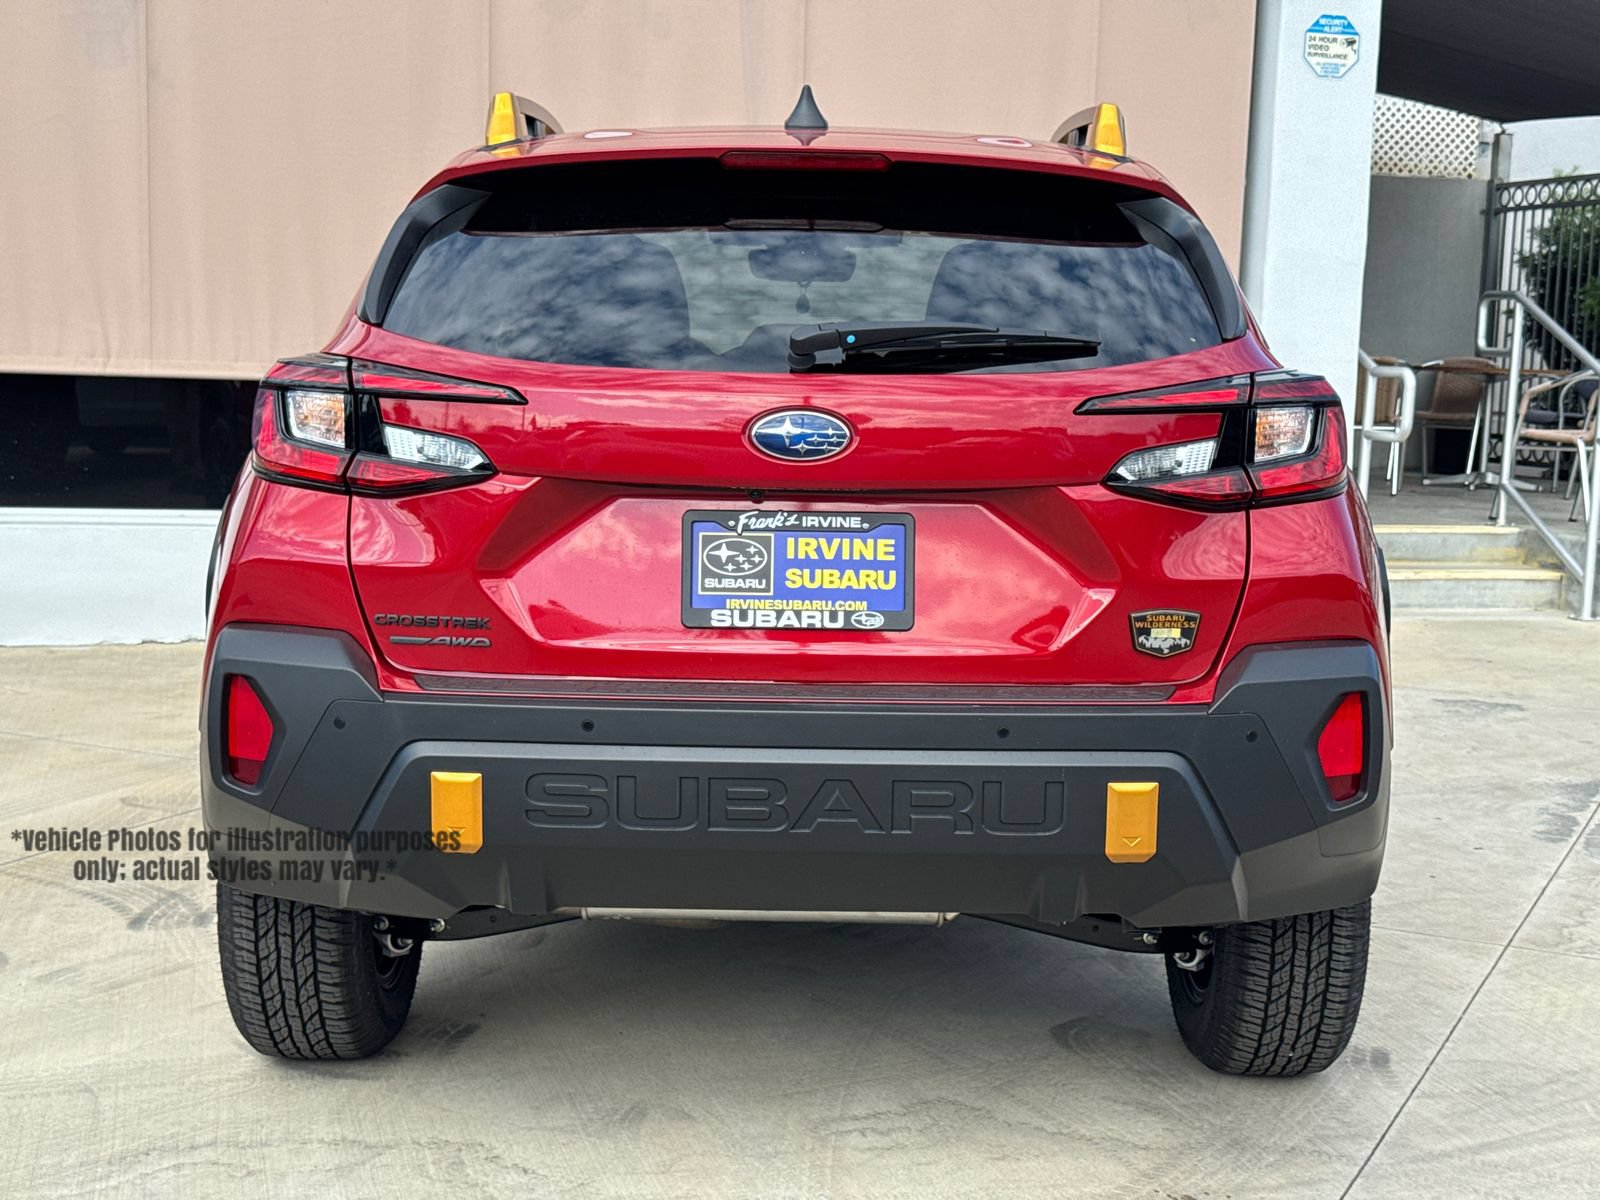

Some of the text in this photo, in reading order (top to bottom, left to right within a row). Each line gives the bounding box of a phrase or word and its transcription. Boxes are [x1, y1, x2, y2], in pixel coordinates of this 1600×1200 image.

[1318, 36, 1338, 44] HOUR
[736, 511, 861, 535] Frank's IRVINE
[787, 537, 896, 560] IRVINE
[704, 578, 767, 589] SUBARU
[785, 568, 896, 590] SUBARU
[726, 599, 867, 611] IRVINESUBARU.COM
[374, 613, 491, 629] CROSSTREK
[711, 609, 845, 629] SUBARU
[1135, 621, 1196, 629] WILDERNESS
[427, 636, 491, 647] AWD
[524, 772, 1066, 836] SUBARU
